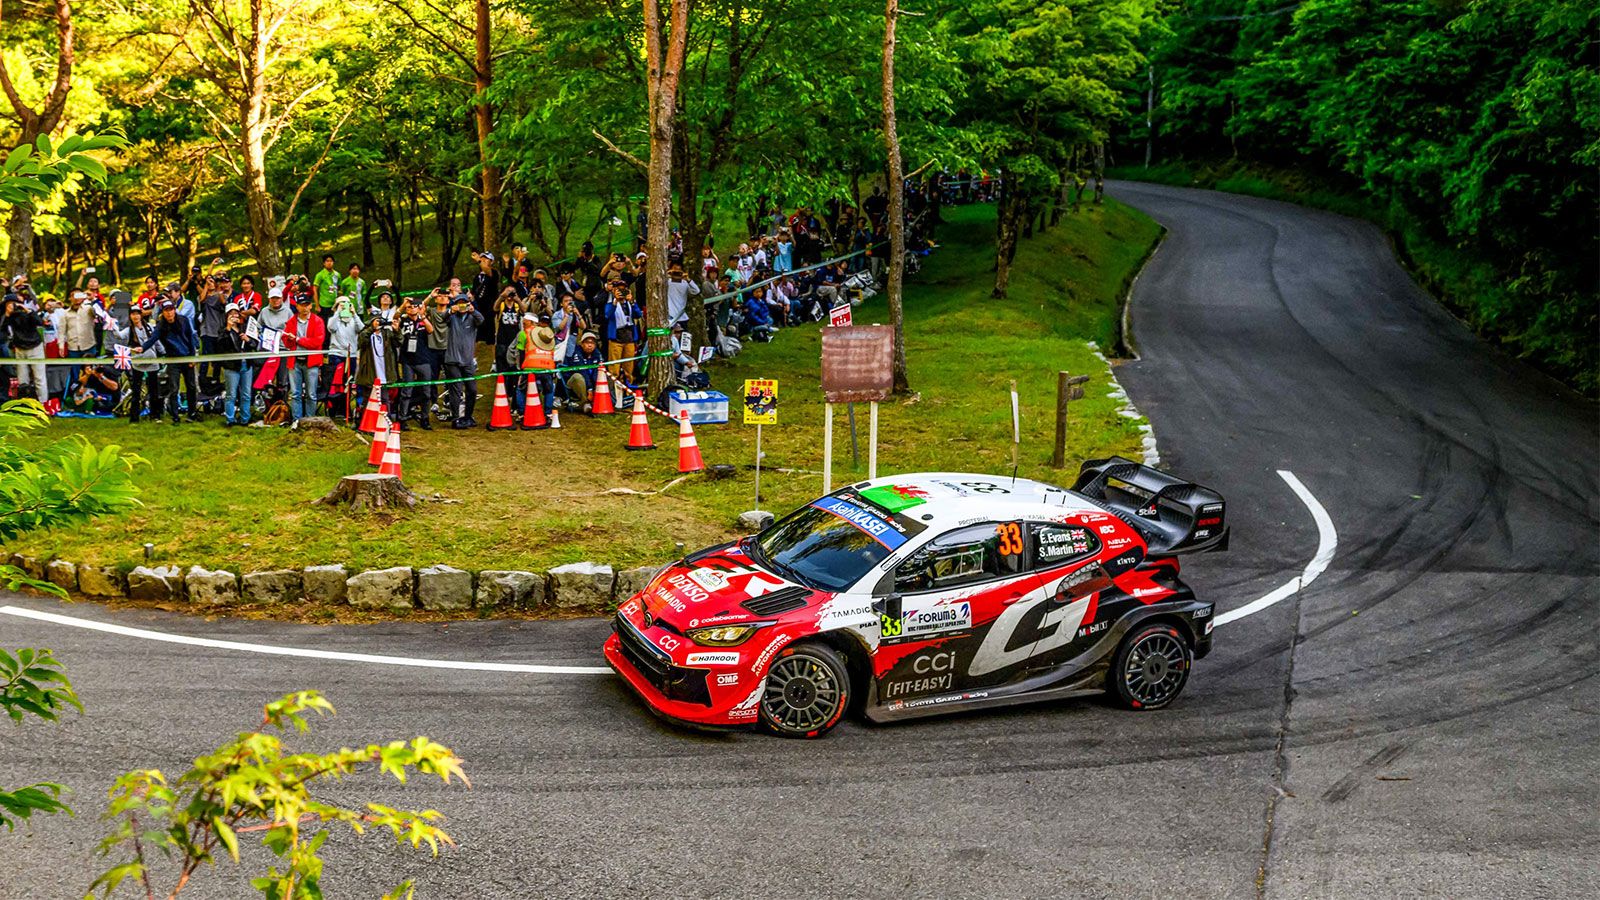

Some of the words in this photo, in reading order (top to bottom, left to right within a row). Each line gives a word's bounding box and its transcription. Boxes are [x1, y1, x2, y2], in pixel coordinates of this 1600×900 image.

[996, 522, 1024, 556] 33
[1040, 532, 1072, 545] E.Evans
[1039, 544, 1074, 558] S.Martin
[668, 573, 709, 603] DENSO
[656, 586, 686, 613] TAMADIC
[832, 606, 871, 618] TAMADIC
[859, 620, 878, 630] PIAA
[881, 613, 902, 637] 33
[755, 635, 792, 677] AUTOMOTIVE
[717, 675, 739, 684] OMP
